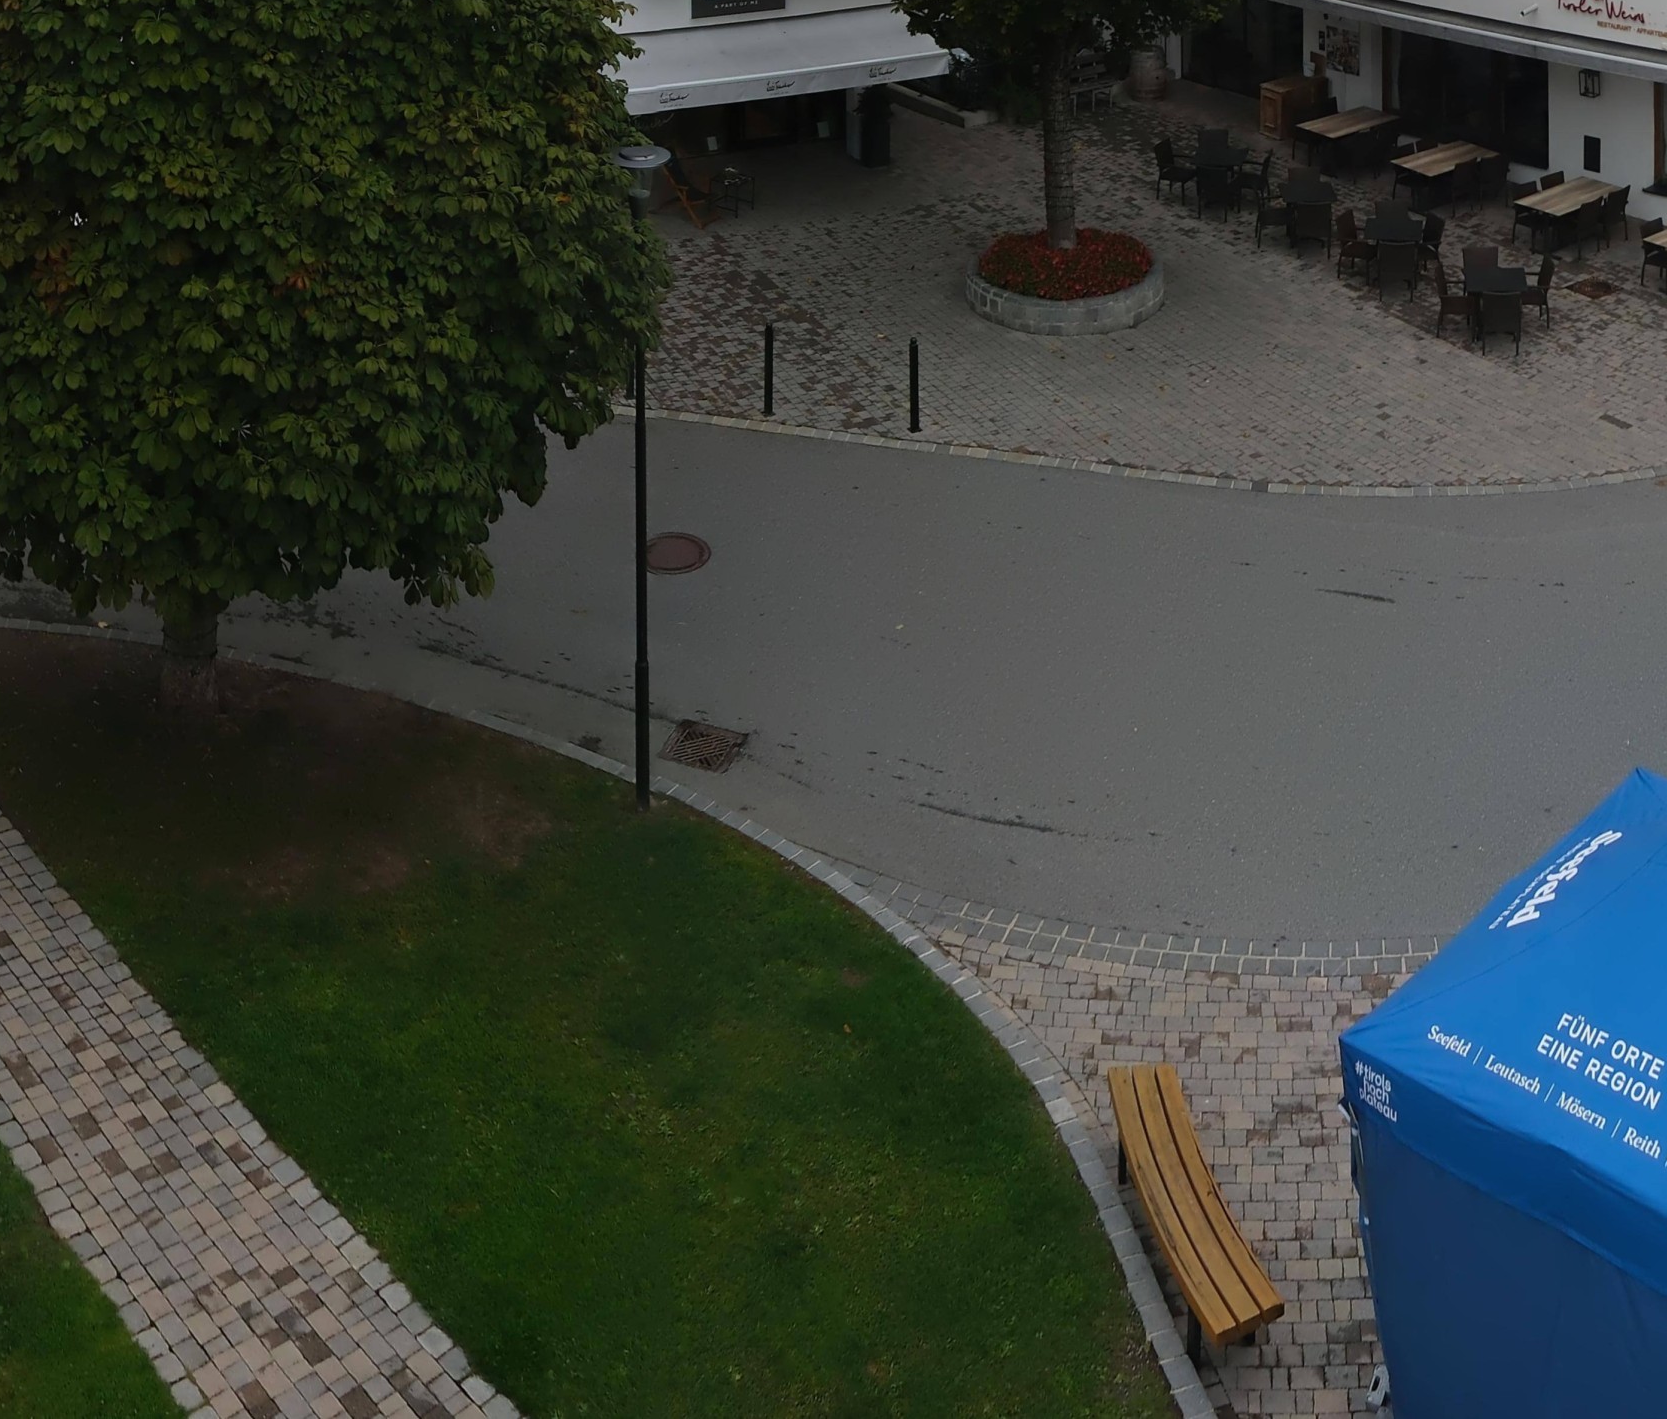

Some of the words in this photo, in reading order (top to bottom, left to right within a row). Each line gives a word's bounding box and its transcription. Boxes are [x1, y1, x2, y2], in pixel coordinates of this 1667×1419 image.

[1596, 21, 1632, 32] RESTAURANT
[1536, 1034, 1581, 1070] EINE
[1584, 1057, 1662, 1110] REGION
[1556, 1012, 1610, 1048] FÜNF
[1610, 1039, 1666, 1079] ORTE
[1427, 1025, 1472, 1058] Seefeld
[1484, 1053, 1542, 1095] Leutasch
[1556, 1091, 1607, 1130] Mösern
[1623, 1126, 1662, 1160] Reith
